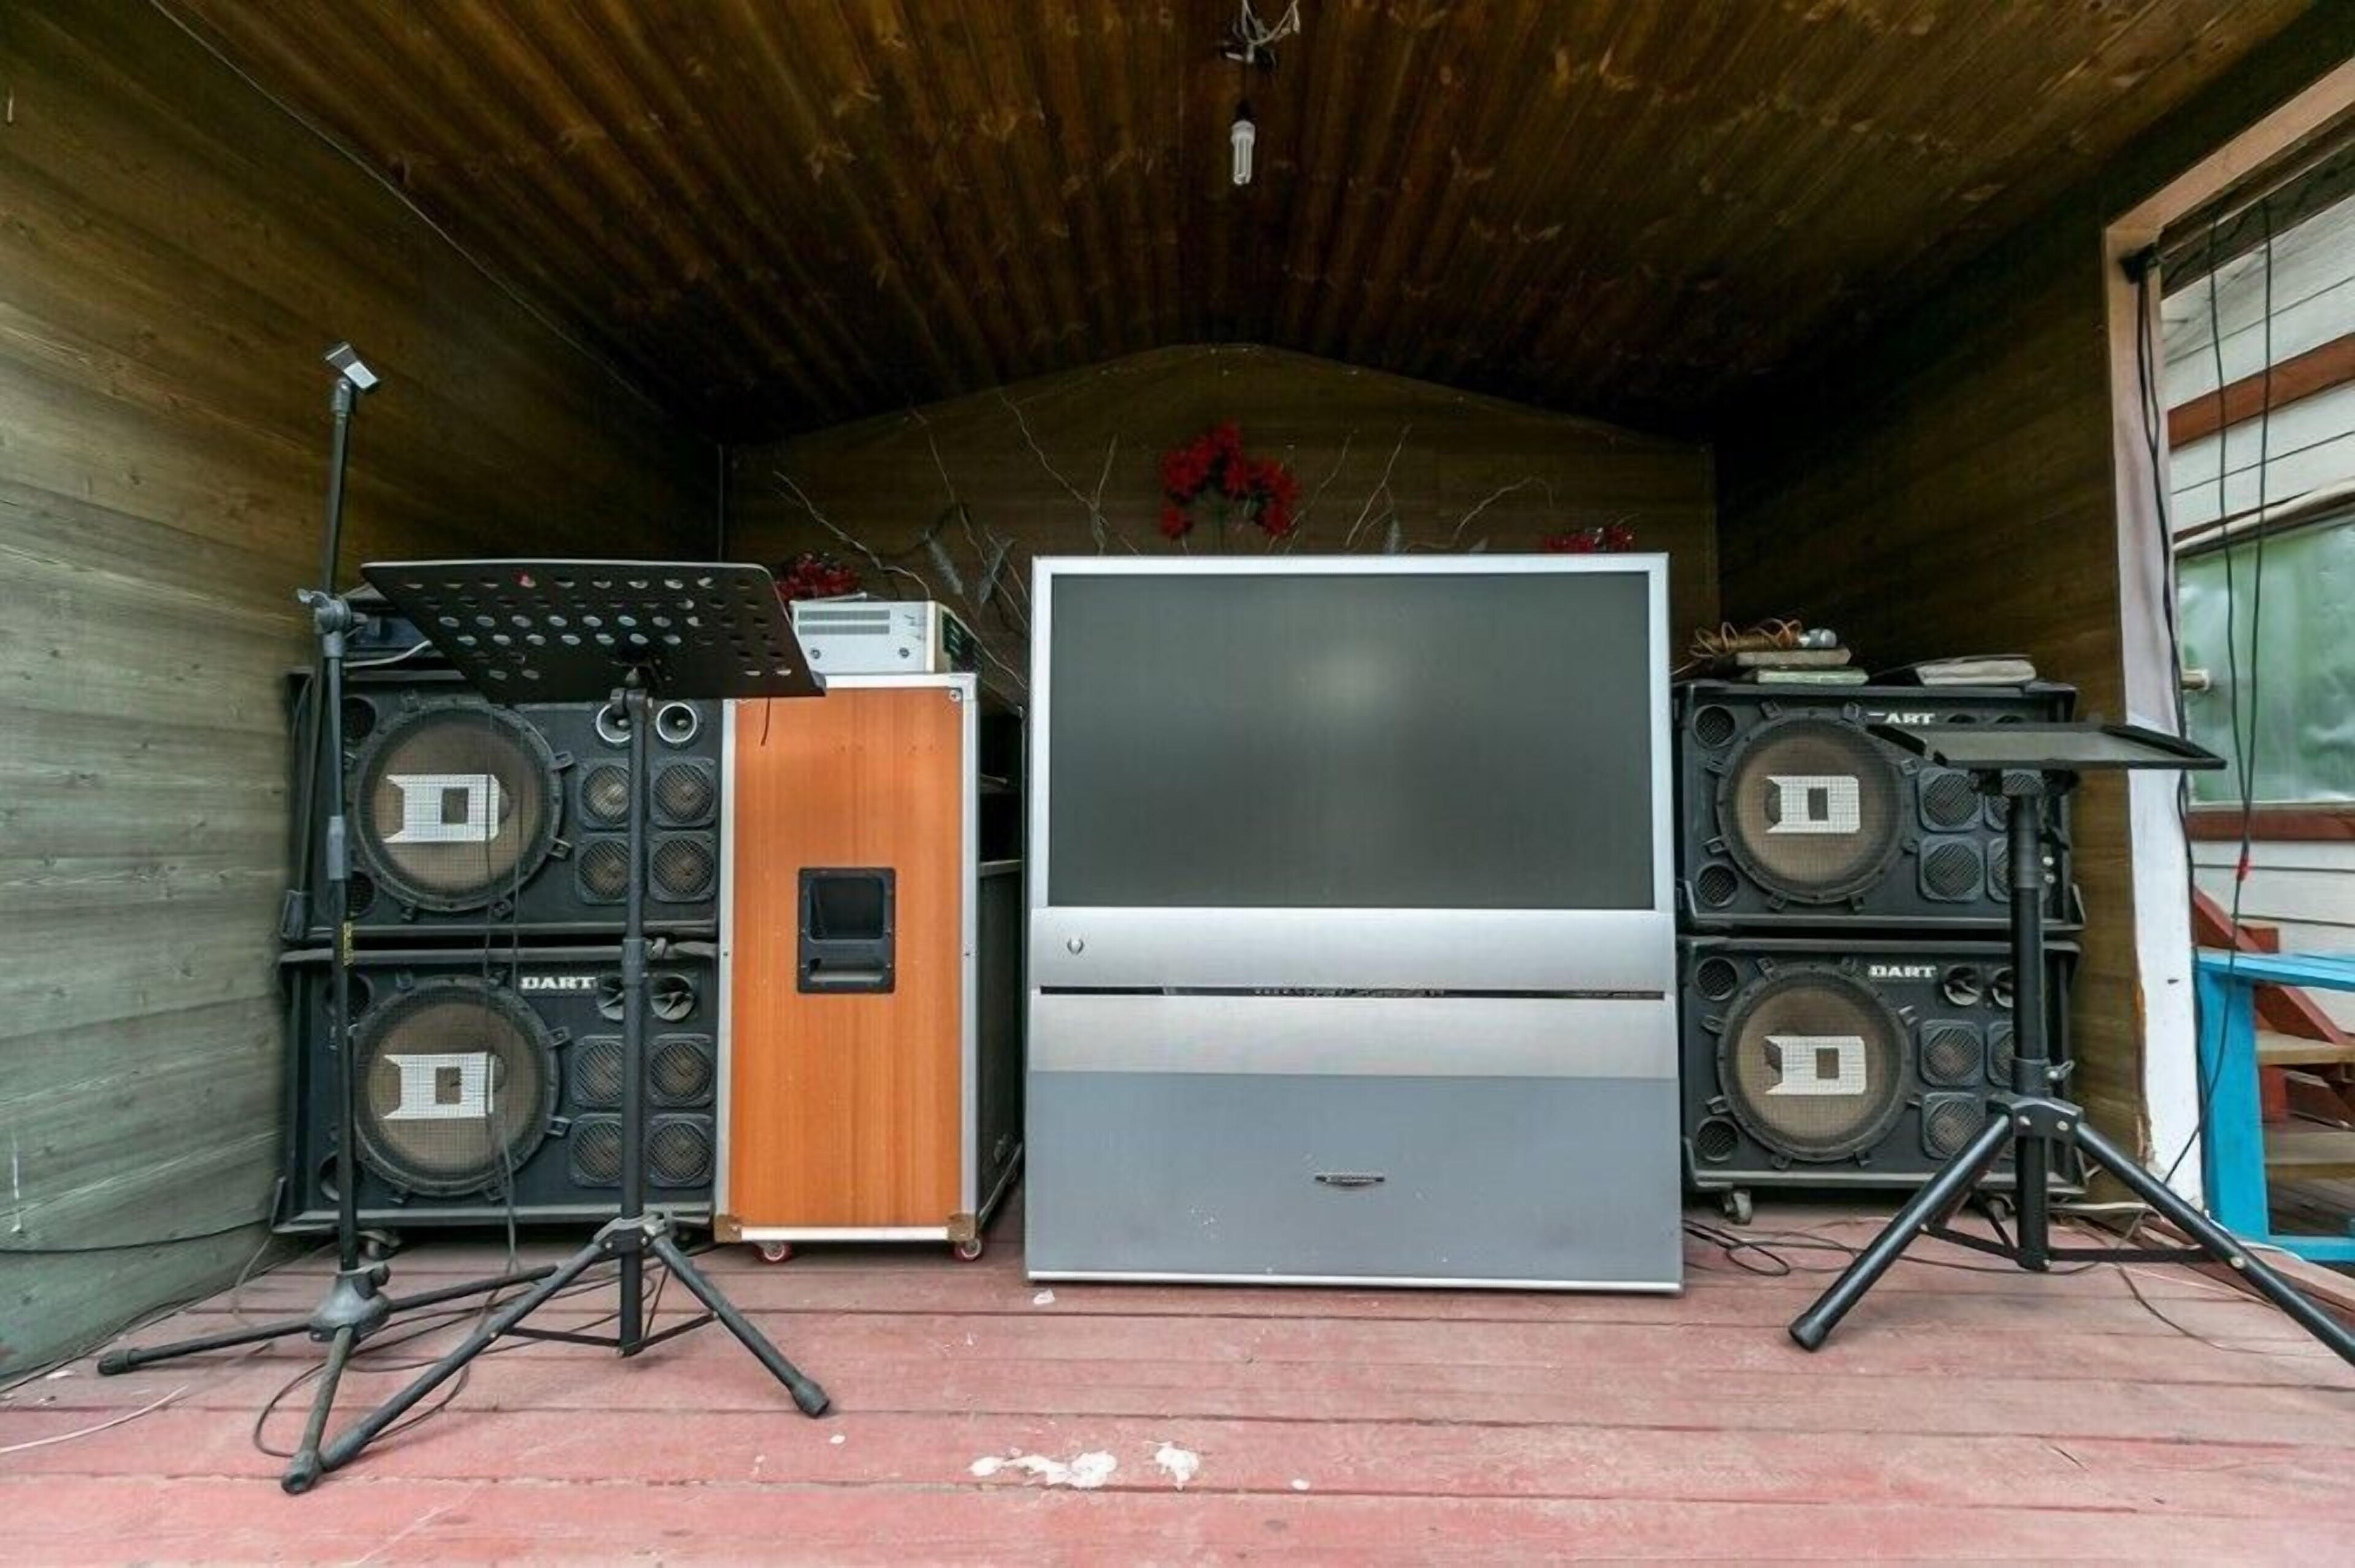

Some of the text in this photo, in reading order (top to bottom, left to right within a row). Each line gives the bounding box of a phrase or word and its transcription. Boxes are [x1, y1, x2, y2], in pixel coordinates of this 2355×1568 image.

[1867, 712, 1936, 725] ART
[1868, 965, 1937, 978] DART
[521, 976, 596, 990] DART
